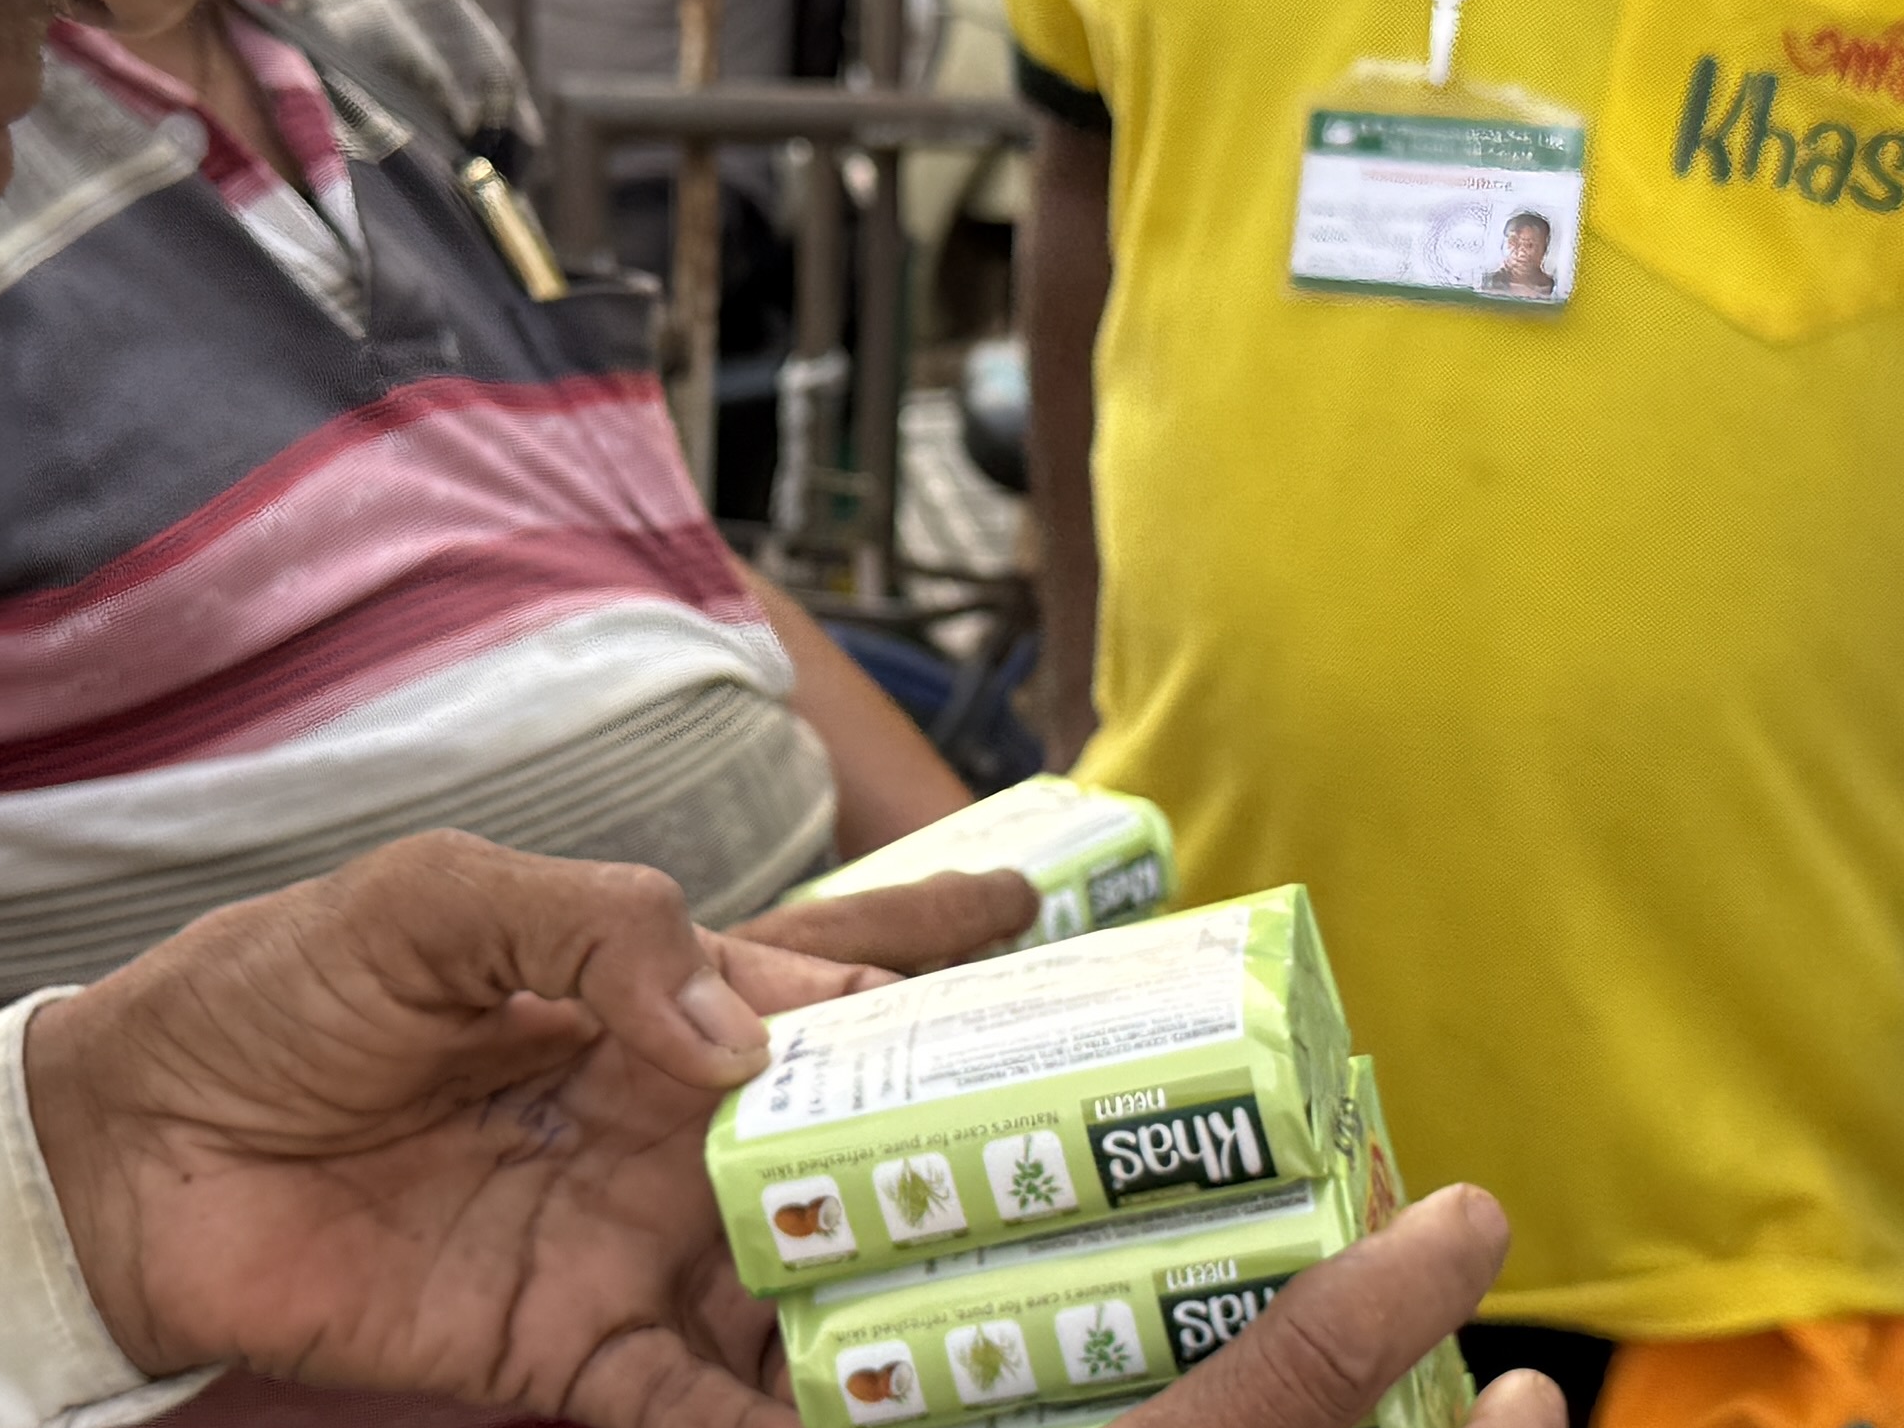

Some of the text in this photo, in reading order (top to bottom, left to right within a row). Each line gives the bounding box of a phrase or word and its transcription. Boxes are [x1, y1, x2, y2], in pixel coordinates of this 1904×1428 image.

[1095, 1087, 1166, 1121] neem
[952, 1124, 989, 1143] care
[995, 1110, 1060, 1134] Nature's
[877, 1133, 923, 1157] pure,
[925, 1132, 950, 1149] for
[1102, 1105, 1264, 1185] Khas
[797, 1144, 876, 1173] refreshed
[1165, 1258, 1238, 1292] neem
[1025, 1293, 1061, 1310] care
[1064, 1279, 1132, 1301] Nature's
[998, 1299, 1023, 1315] for
[872, 1312, 948, 1339] refreshed
